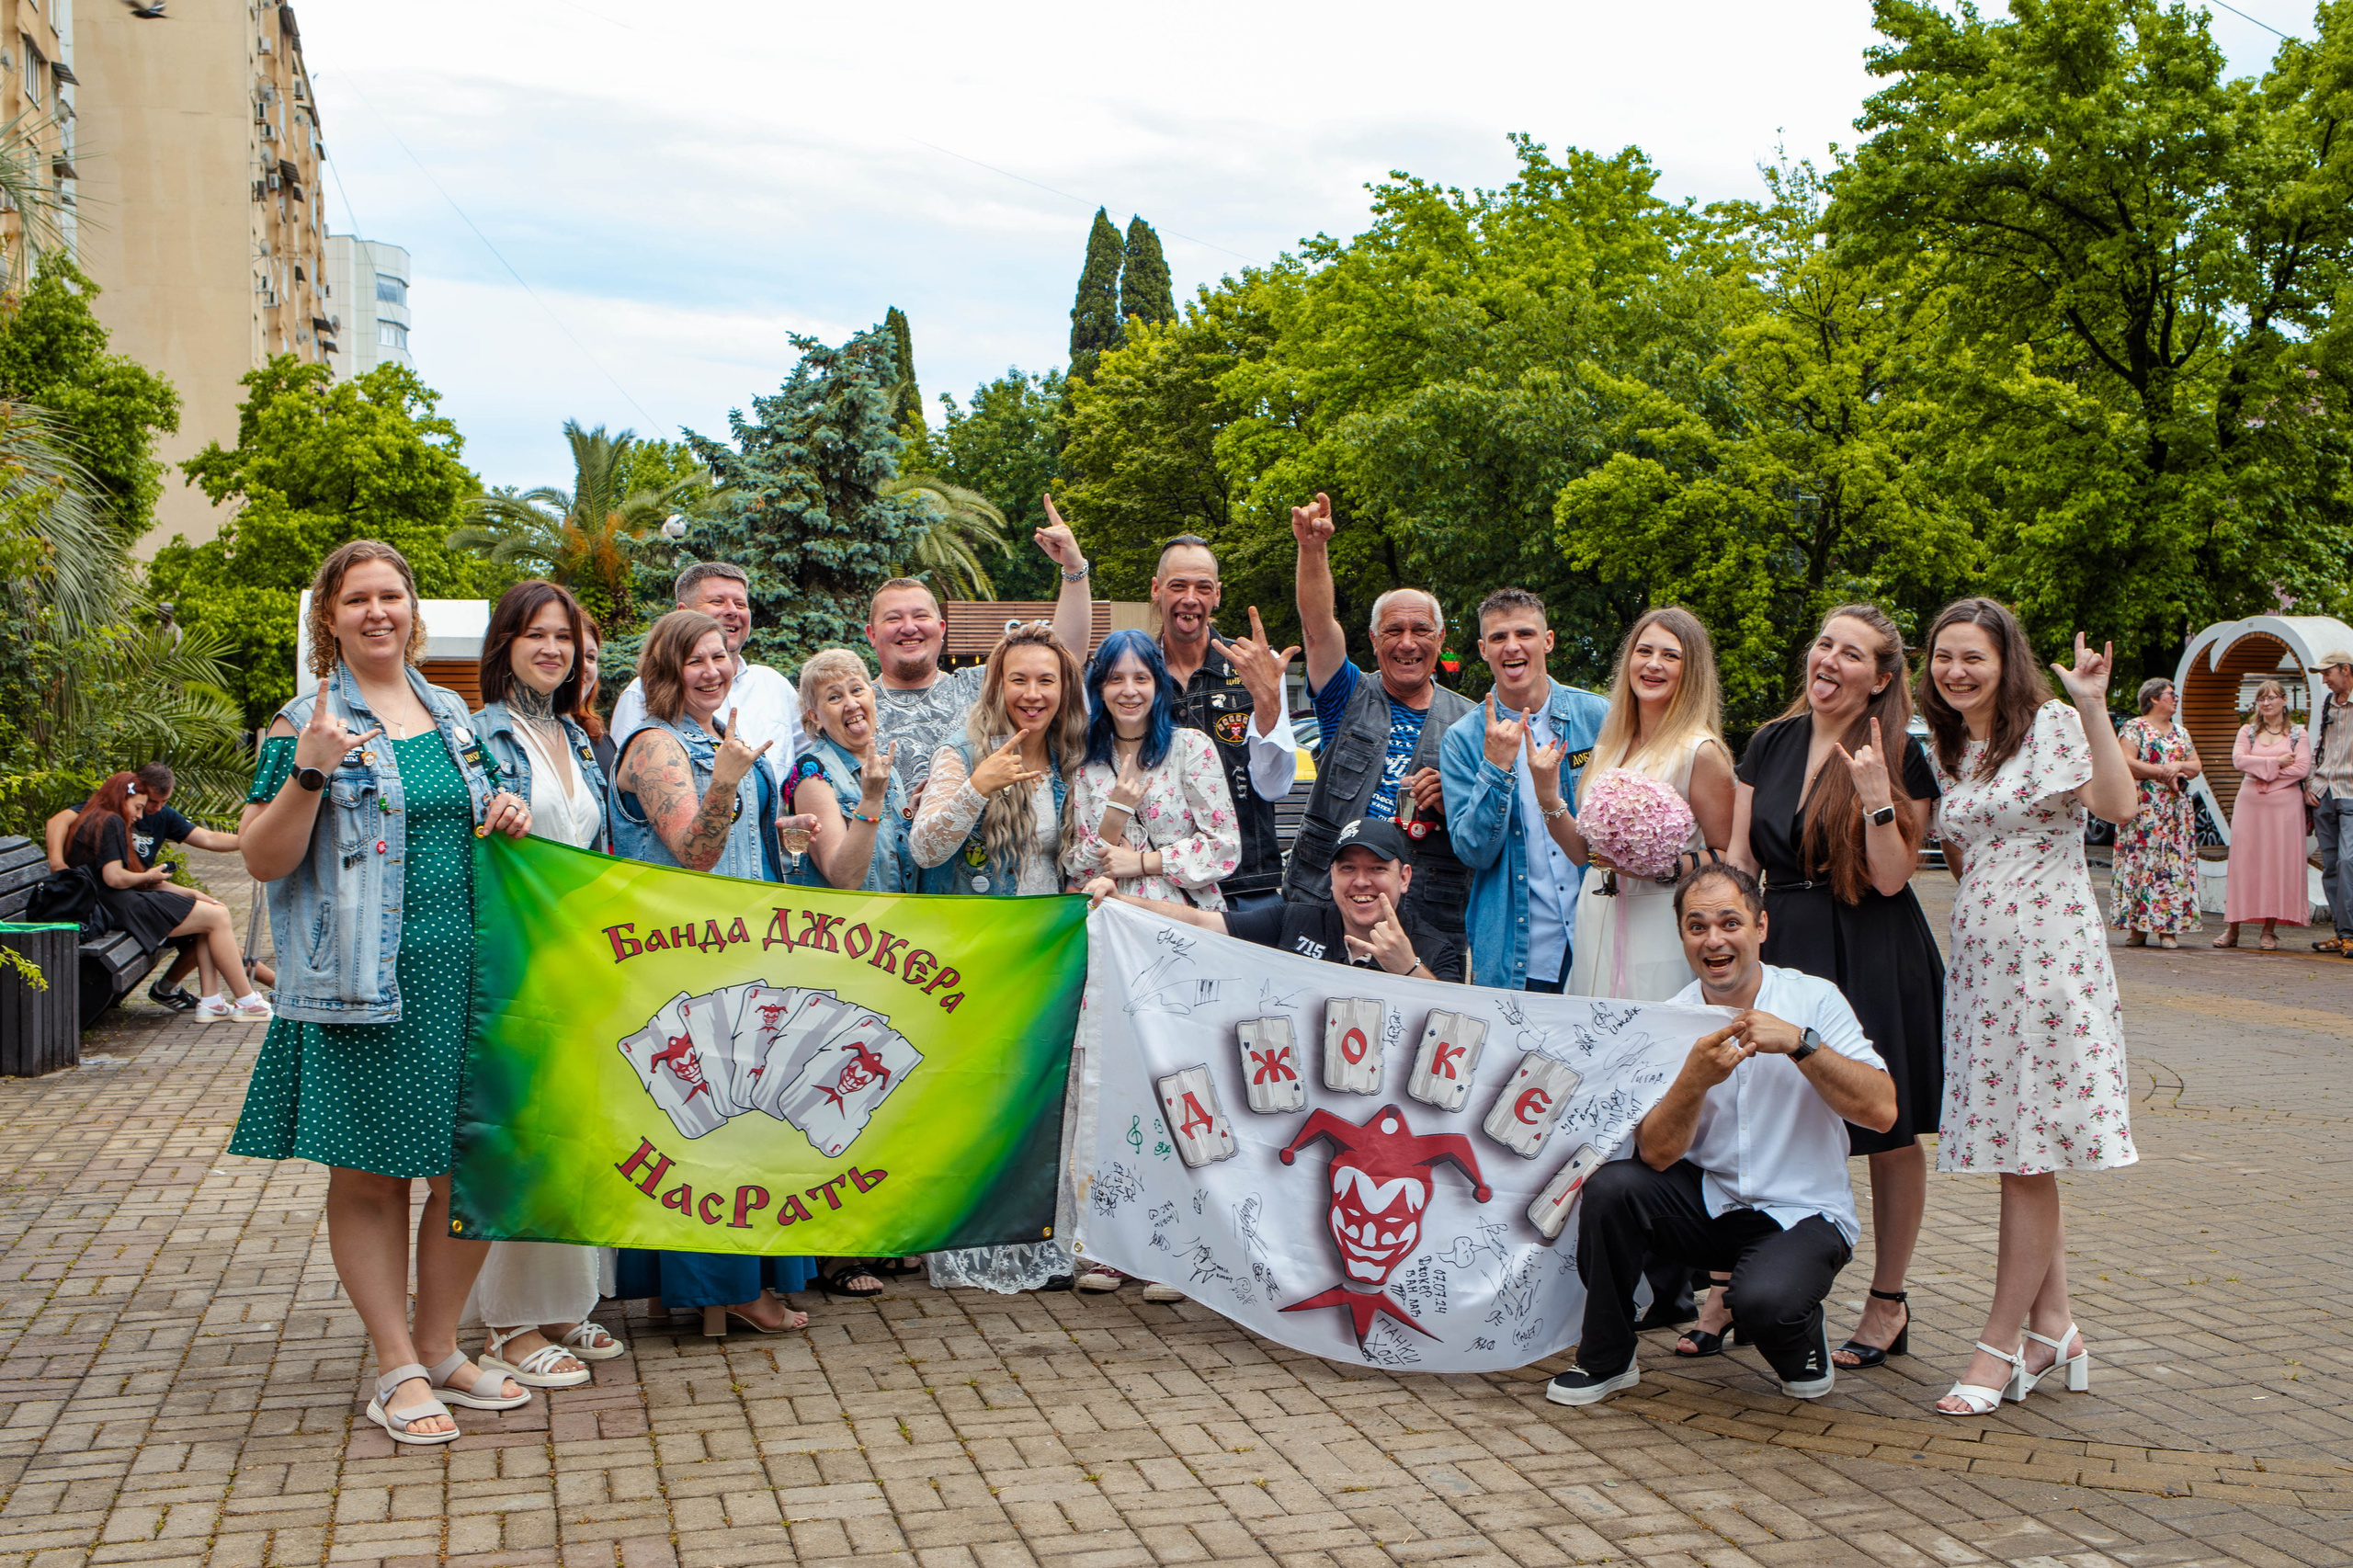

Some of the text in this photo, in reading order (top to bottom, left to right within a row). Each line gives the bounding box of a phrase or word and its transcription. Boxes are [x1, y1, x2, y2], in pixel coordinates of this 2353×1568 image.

[601, 917, 750, 964] Банда
[1296, 935, 1327, 960] 715
[1433, 1269, 1448, 1313] 07.07.24
[1377, 1318, 1422, 1363] ПАНКИ
